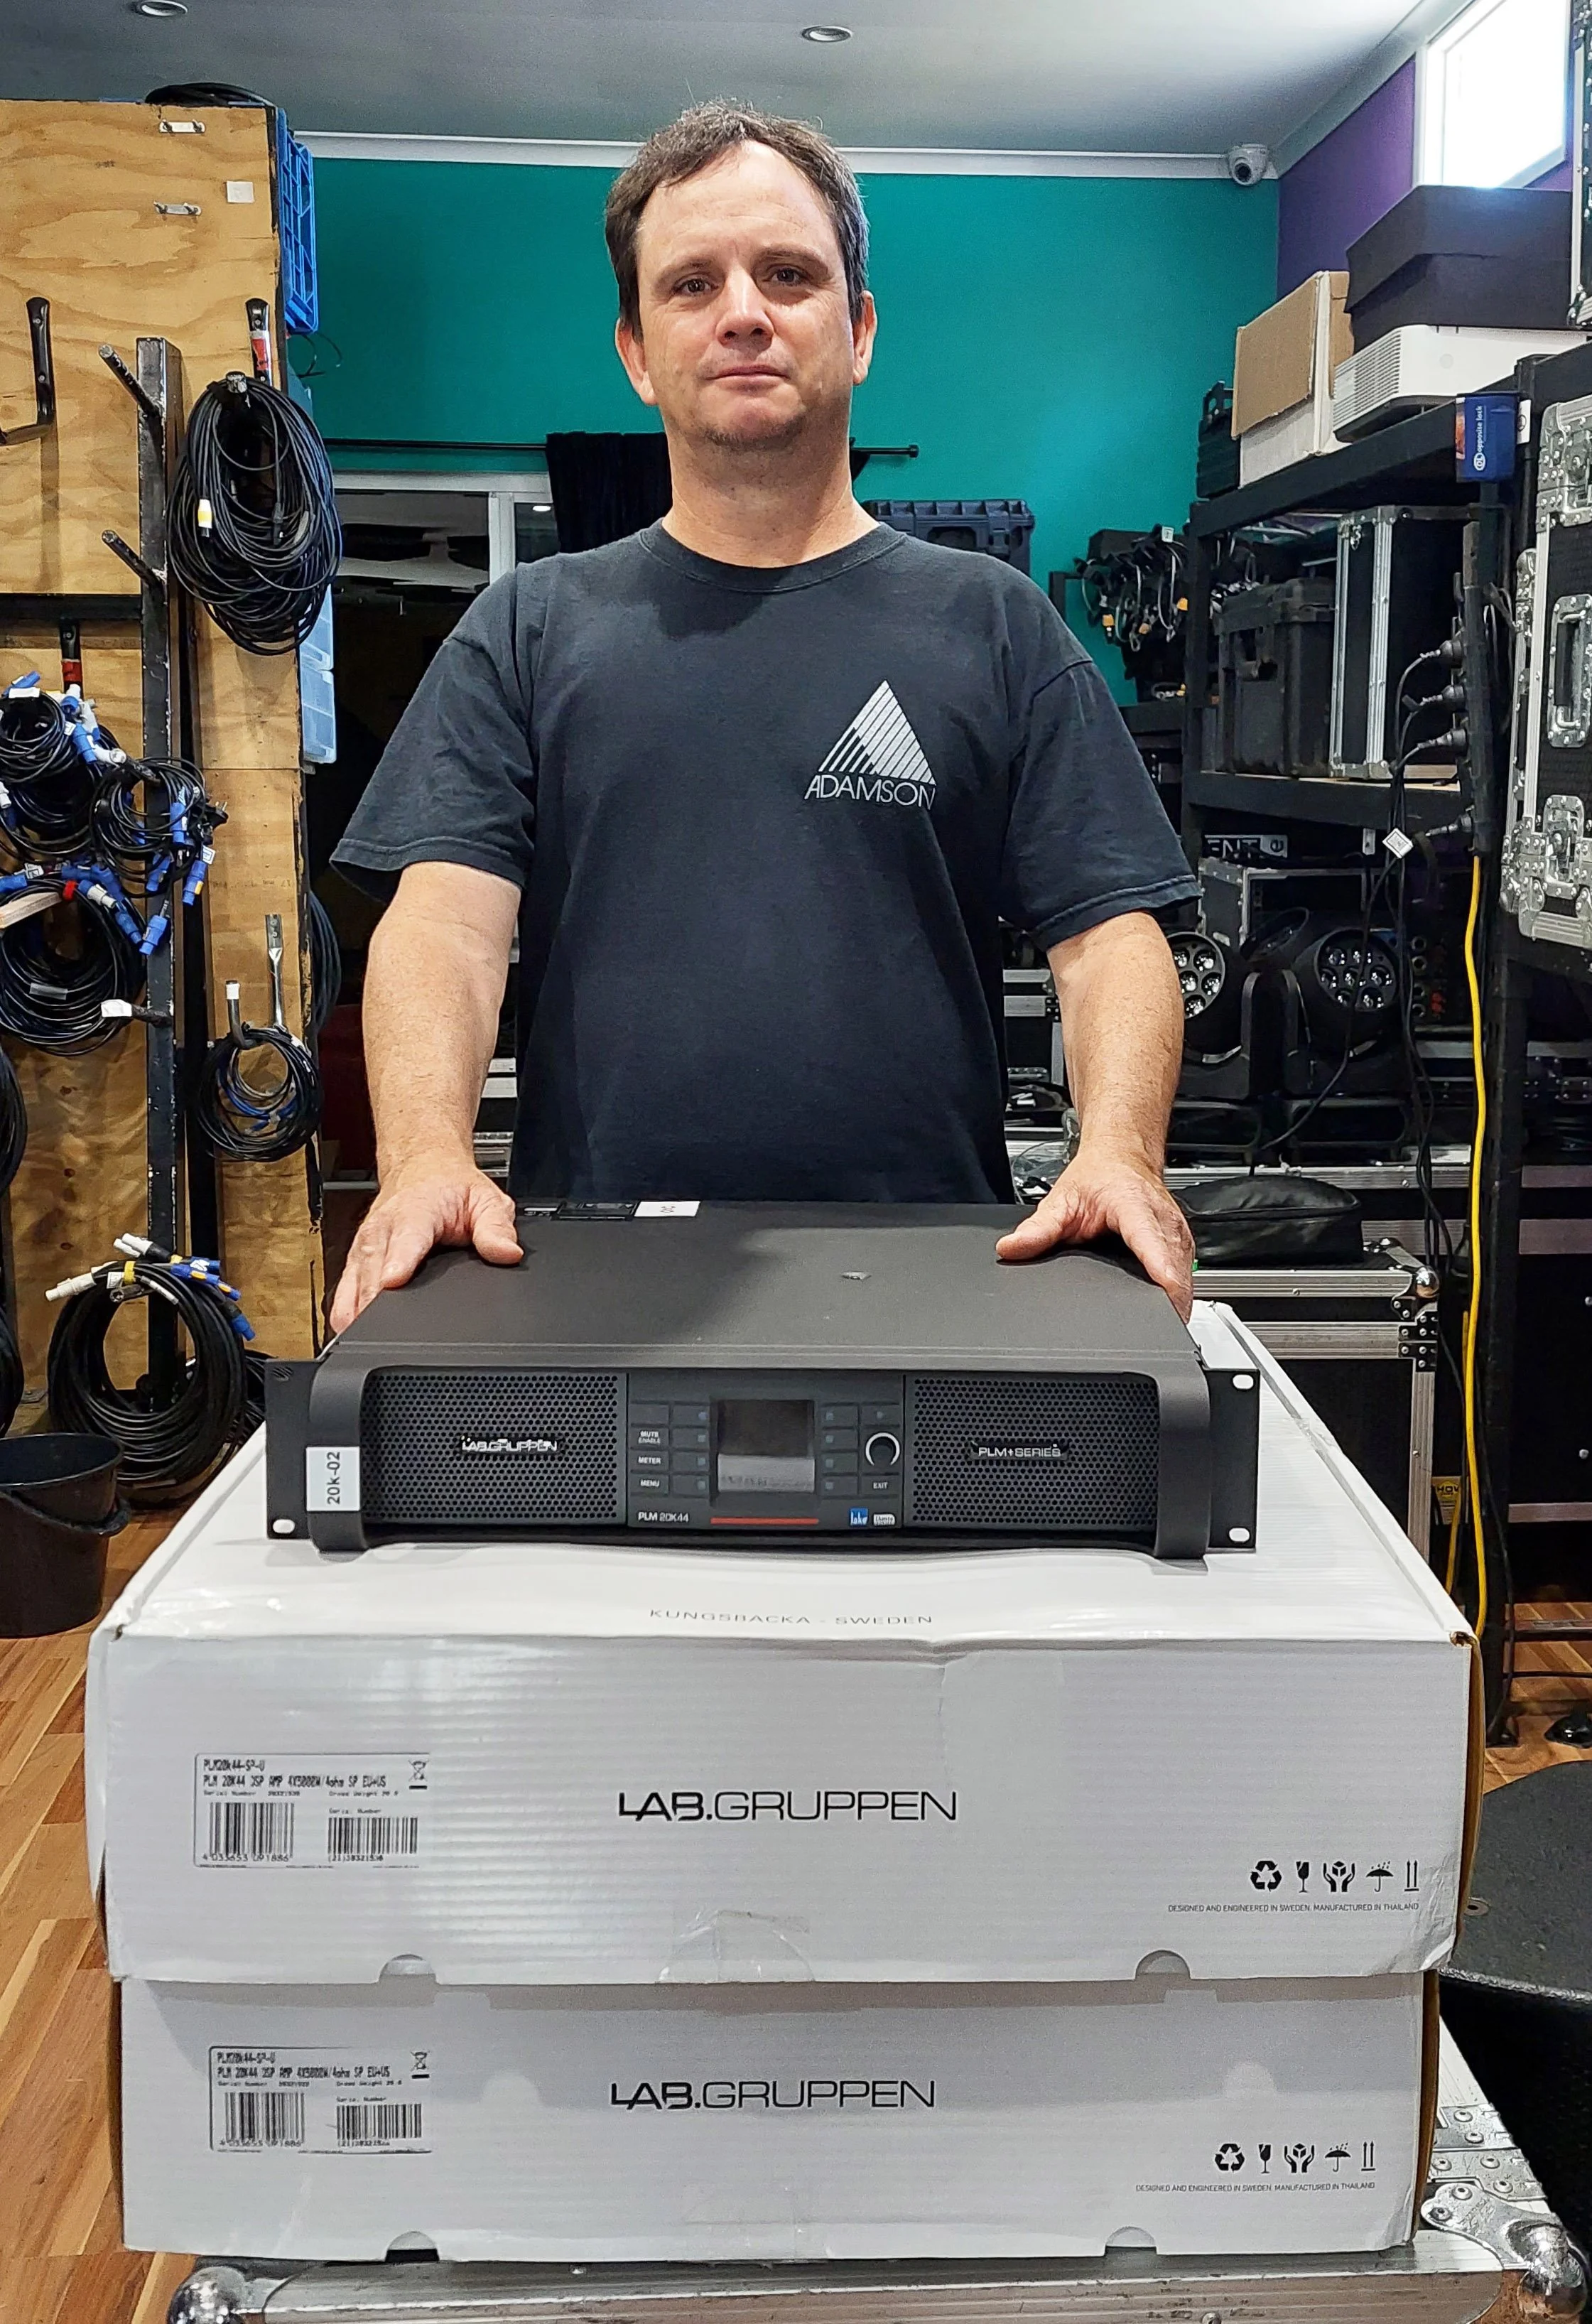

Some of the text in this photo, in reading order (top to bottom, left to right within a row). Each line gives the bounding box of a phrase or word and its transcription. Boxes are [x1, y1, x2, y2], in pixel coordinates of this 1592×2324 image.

[803, 774, 936, 811] ADAMSON
[978, 1447, 1061, 1457] PLM+SERIES
[638, 1456, 661, 1464] METER
[640, 1479, 660, 1487] MENU
[638, 1511, 658, 1521] PLM
[650, 1609, 811, 1624] KUNGSBACKA
[835, 1616, 933, 1624] SWEDEN
[619, 1790, 956, 1822] LAB.GRUPPEN
[610, 2080, 935, 2110] LAB.GRUPPEN
[1274, 2183, 1331, 2191] MANUFACTURED
